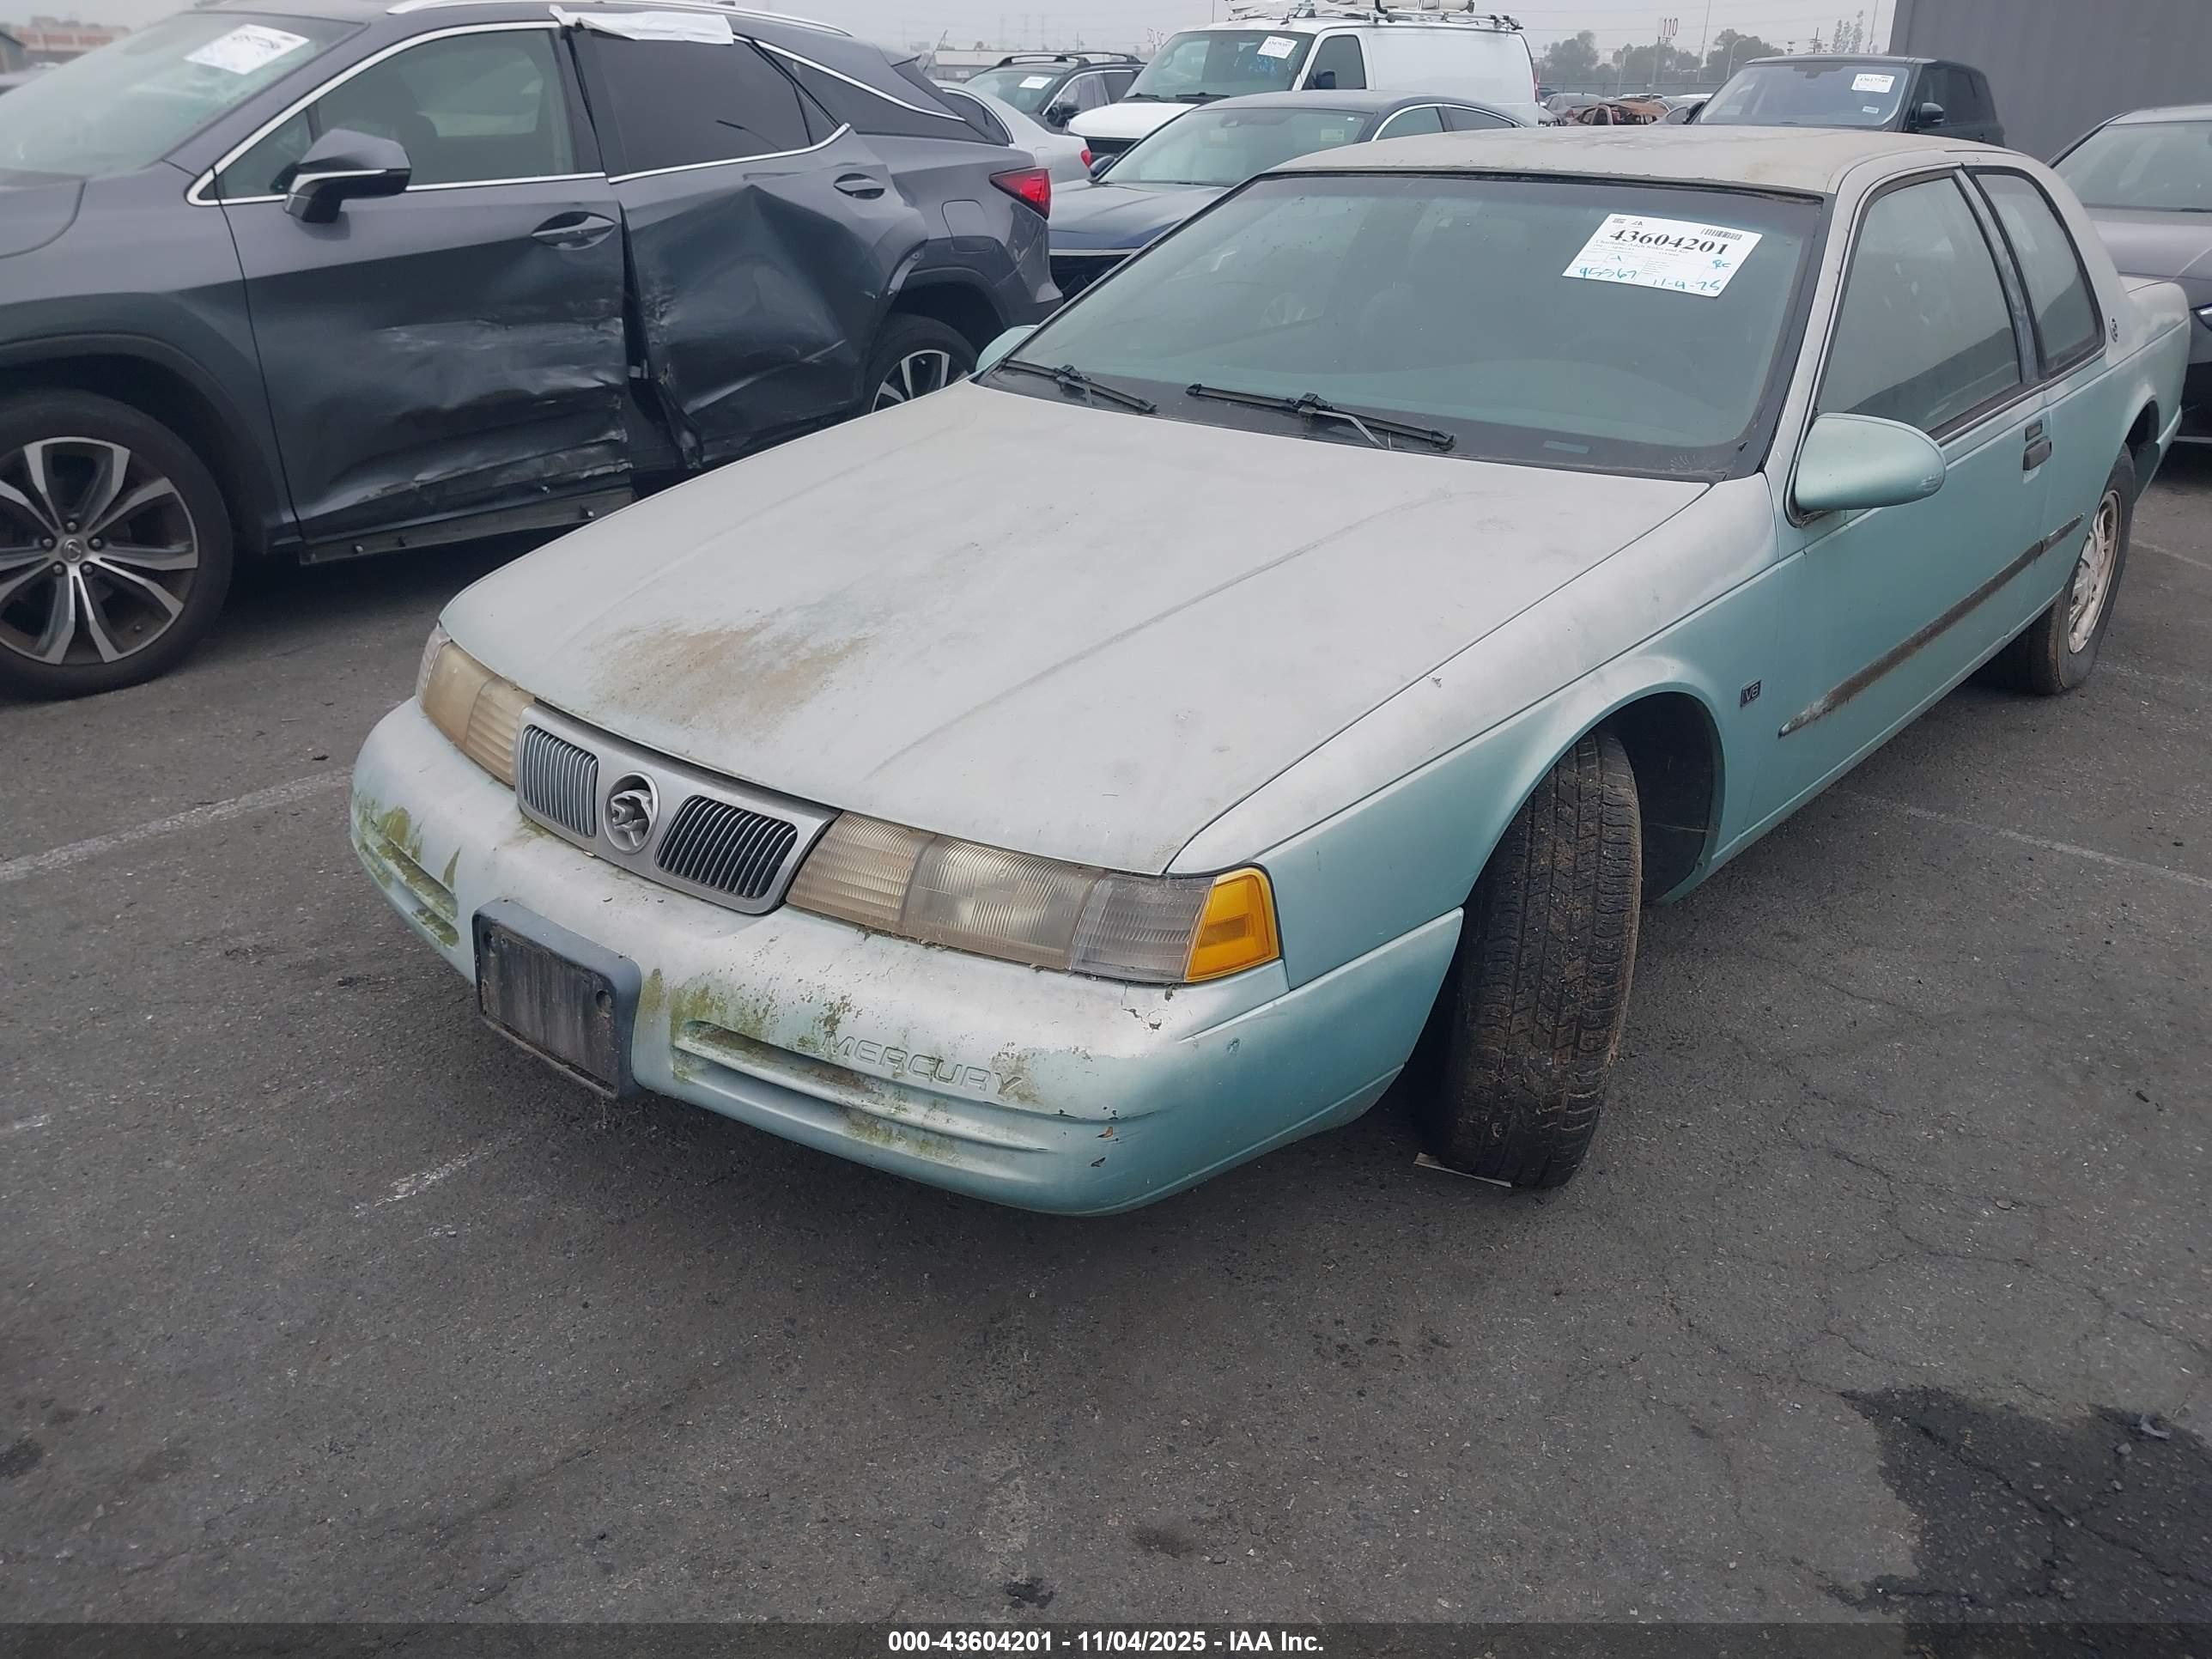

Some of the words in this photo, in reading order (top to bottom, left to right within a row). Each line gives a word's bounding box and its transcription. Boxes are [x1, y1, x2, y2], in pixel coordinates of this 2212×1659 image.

[1662, 17, 1679, 36] 110
[1609, 228, 1729, 255] 43604201
[820, 1030, 1022, 1098] MERCURY
